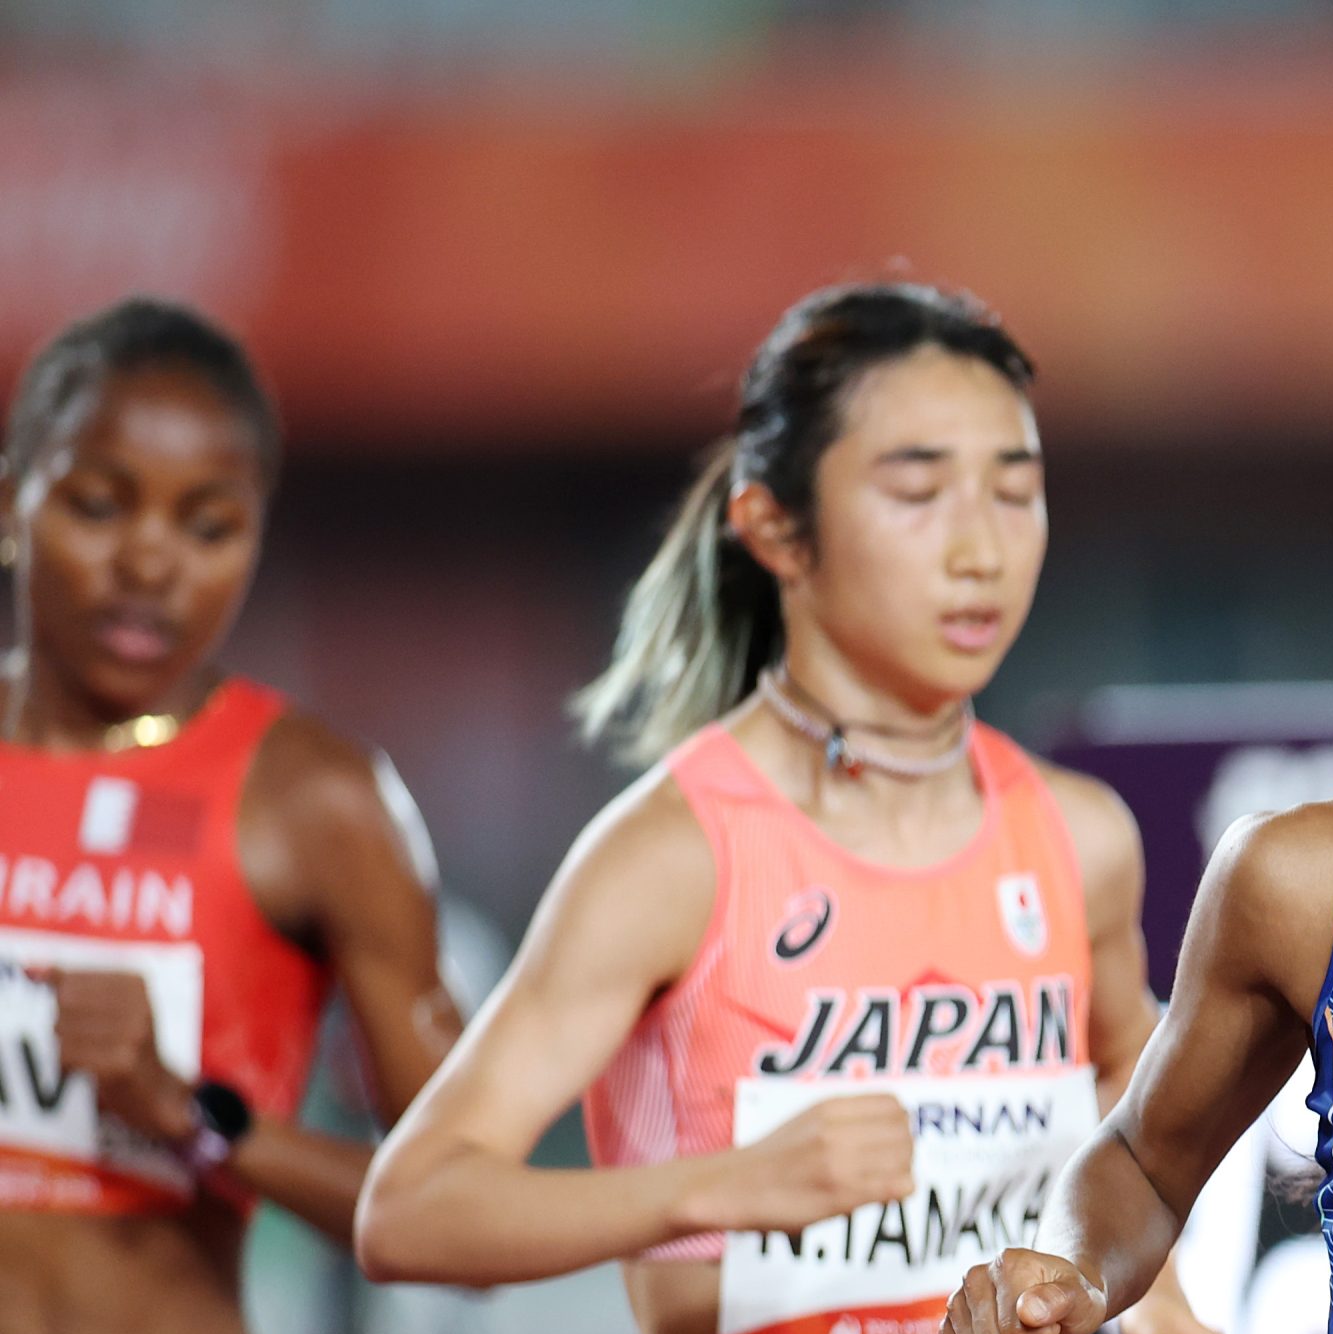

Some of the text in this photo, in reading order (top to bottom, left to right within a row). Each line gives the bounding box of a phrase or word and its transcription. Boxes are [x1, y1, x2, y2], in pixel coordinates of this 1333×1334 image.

[0, 853, 194, 937] RAIN
[756, 979, 1073, 1076] JAPAN
[914, 1102, 1053, 1136] RNAN
[757, 1168, 1049, 1264] .ANAKA
